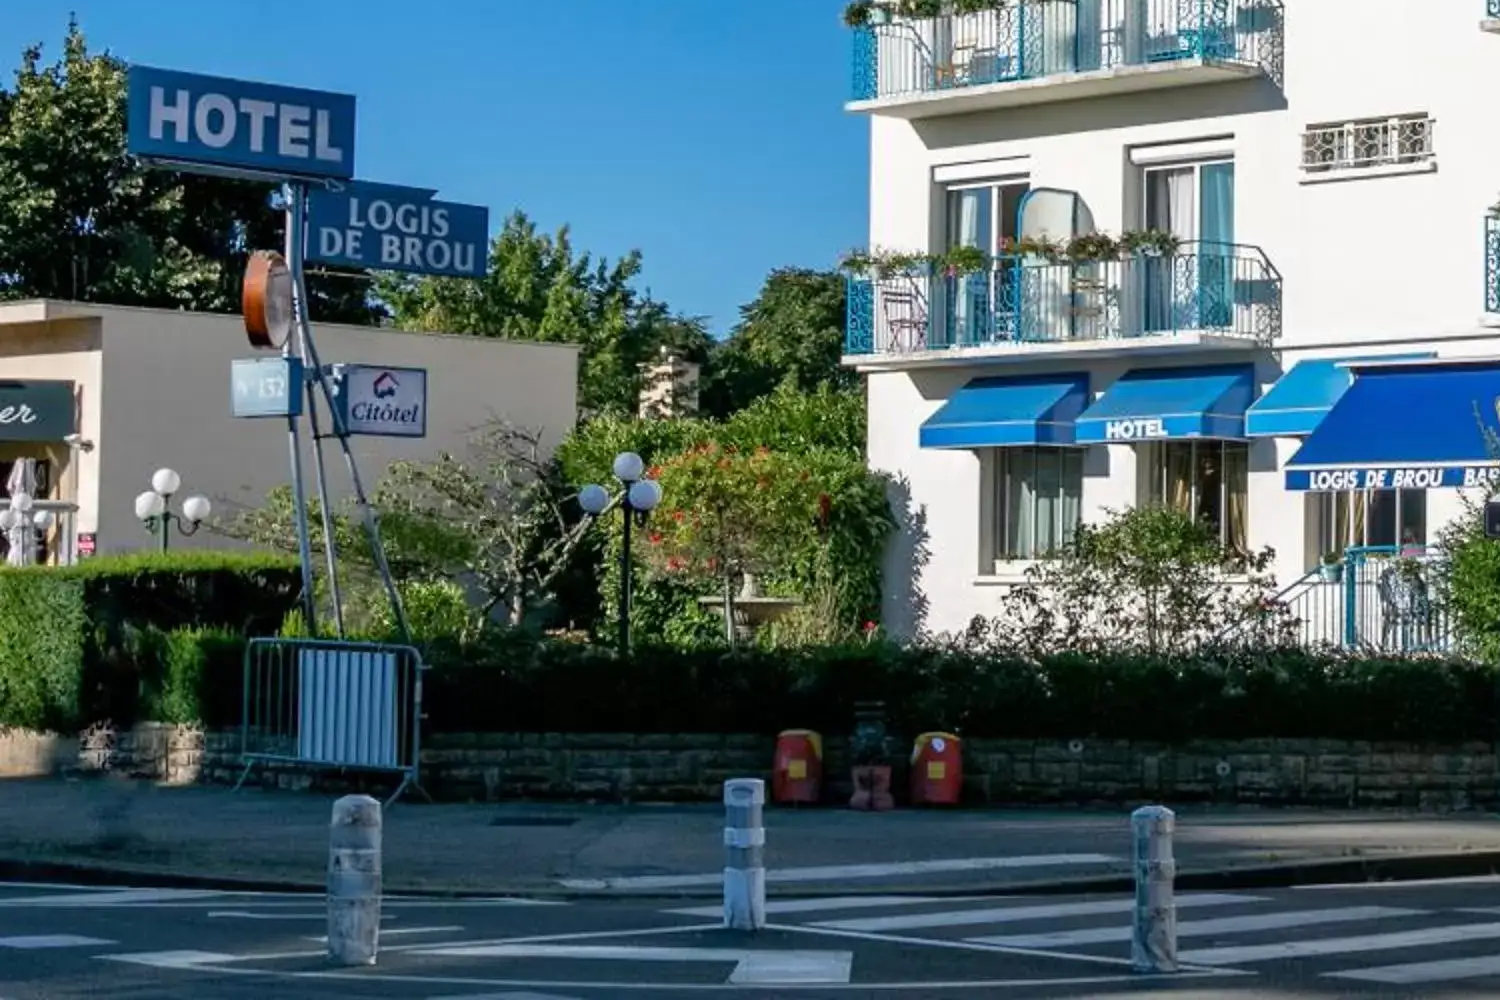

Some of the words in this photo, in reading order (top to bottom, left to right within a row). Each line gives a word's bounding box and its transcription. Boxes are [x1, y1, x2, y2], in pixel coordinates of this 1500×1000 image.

[150, 86, 343, 162] HOTEL
[349, 198, 450, 237] LOGIS
[319, 227, 364, 260] DE
[381, 233, 476, 273] BROU
[352, 402, 419, 423] Citôtel
[1106, 420, 1168, 439] HOTEL
[1309, 470, 1358, 489] LOGIS
[1365, 469, 1388, 488] DE
[1392, 467, 1444, 488] BROU
